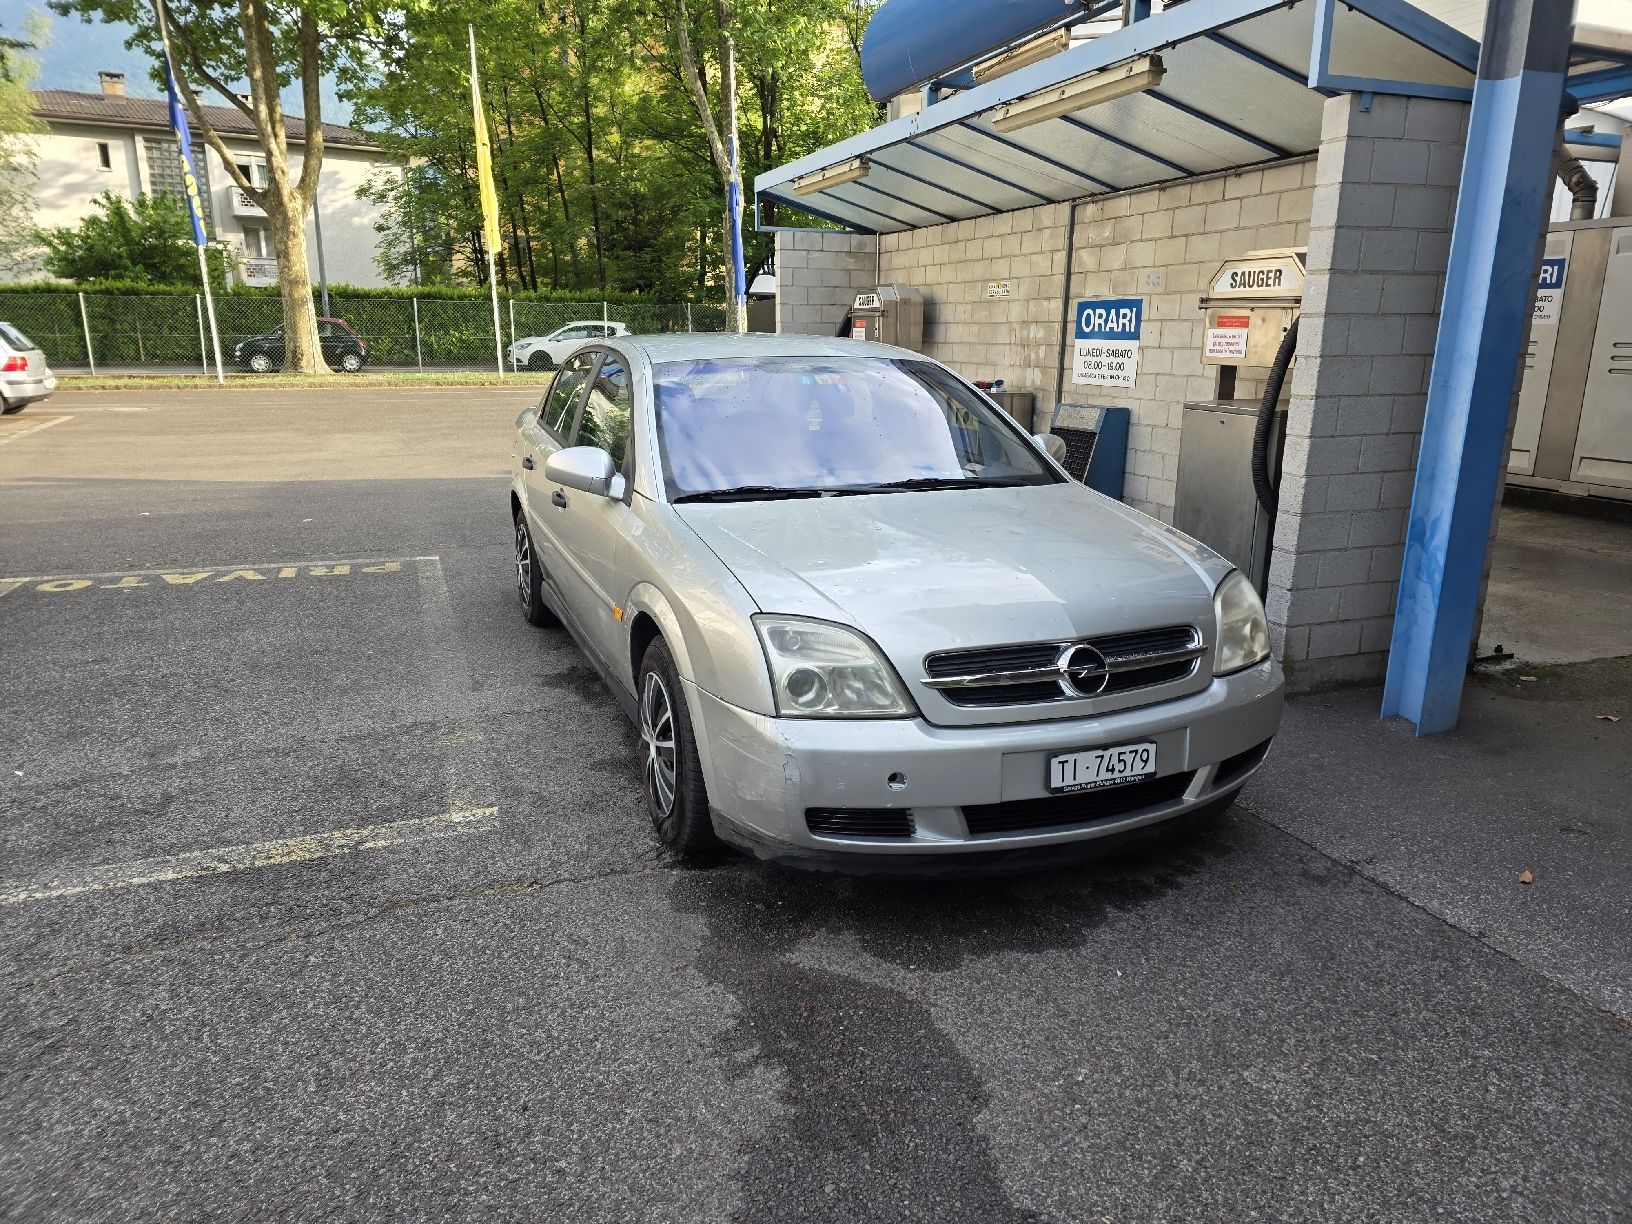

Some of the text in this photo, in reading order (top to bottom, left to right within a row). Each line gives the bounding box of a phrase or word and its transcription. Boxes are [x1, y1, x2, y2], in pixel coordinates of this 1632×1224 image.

[1229, 268, 1283, 289] SAUGER
[1539, 265, 1559, 284] RI
[1081, 307, 1137, 333] ORARI
[35, 562, 401, 592] PRIVATO
